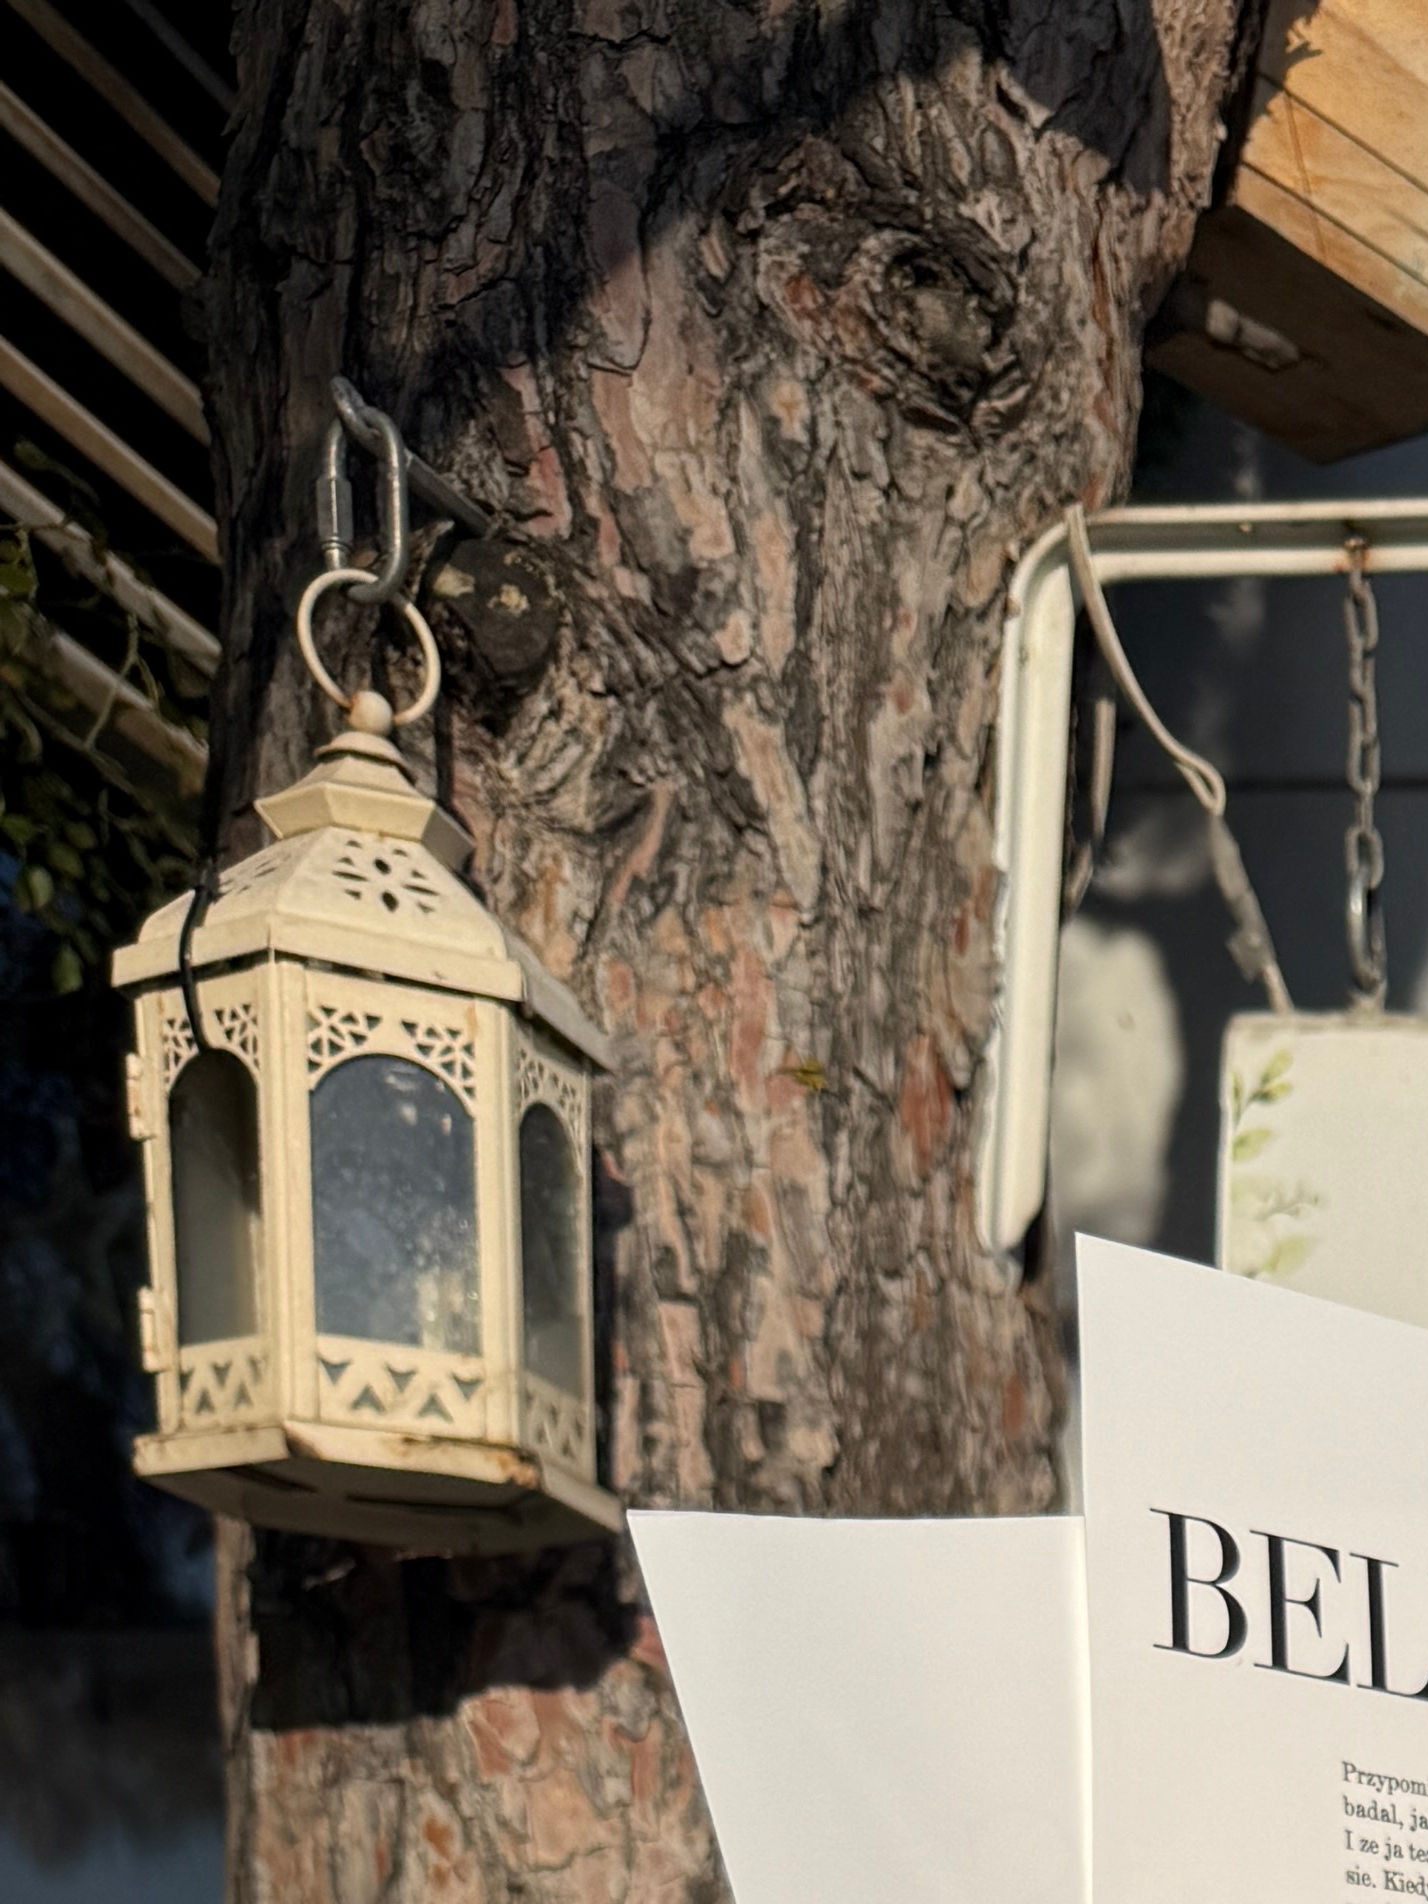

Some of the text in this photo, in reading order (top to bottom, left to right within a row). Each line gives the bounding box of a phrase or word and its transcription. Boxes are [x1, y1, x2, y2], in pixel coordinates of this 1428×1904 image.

[1342, 1794, 1404, 1830] badal,
[1344, 1828, 1353, 1851] I
[1359, 1838, 1380, 1855] ze
[1383, 1842, 1405, 1862] ja
[1345, 1870, 1377, 1889] sie.
